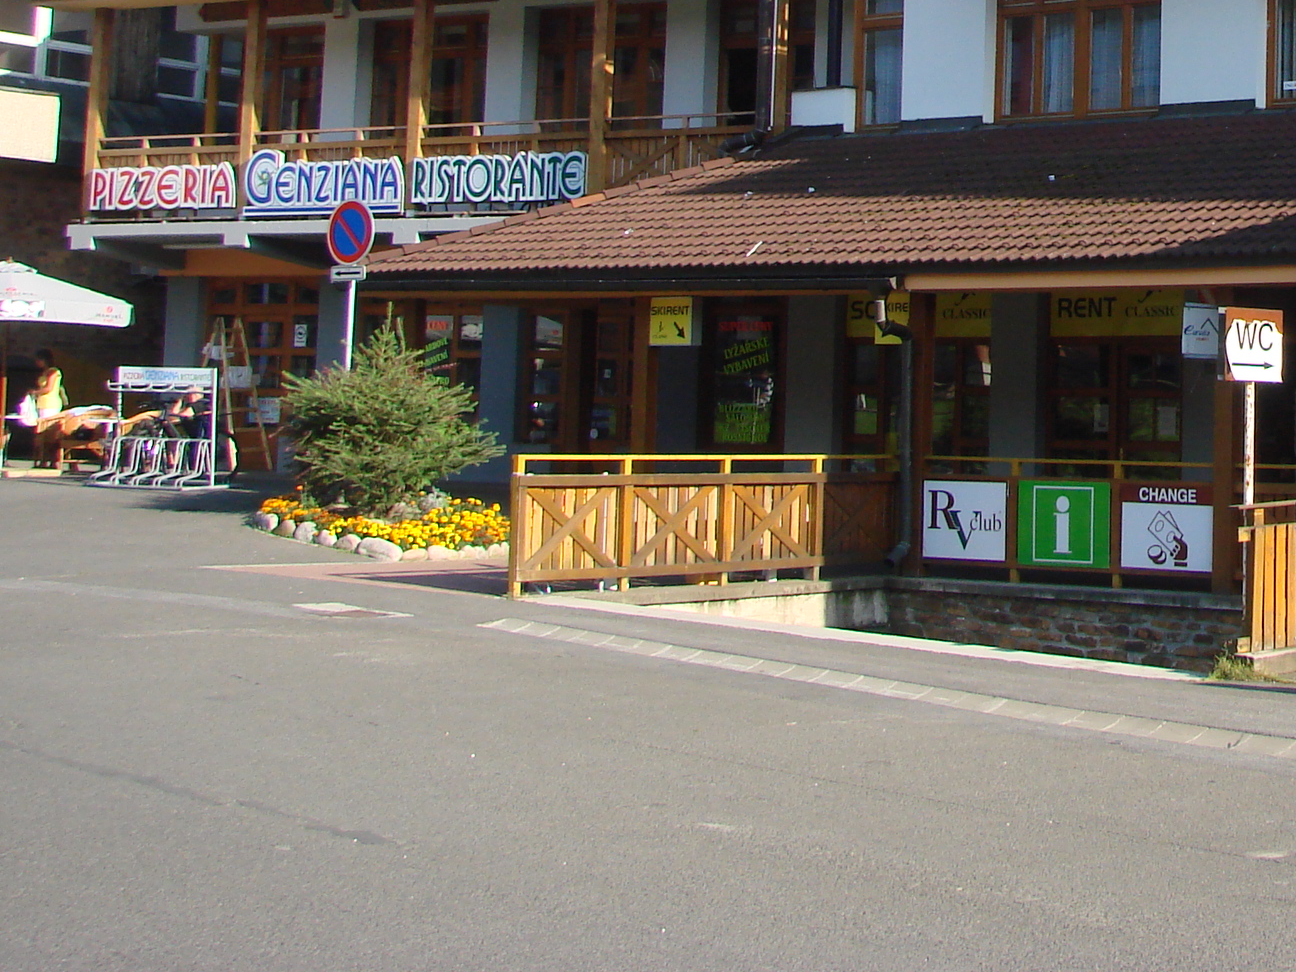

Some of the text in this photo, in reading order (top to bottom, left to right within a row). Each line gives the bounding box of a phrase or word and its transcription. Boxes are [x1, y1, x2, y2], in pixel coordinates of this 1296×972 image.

[91, 149, 588, 210] PIZZERIA GENZIANA RISTORANTE
[651, 305, 690, 316] SKIRENT
[942, 307, 991, 320] CLASSIC
[1058, 296, 1179, 319] RENT CLASSIC
[1235, 322, 1274, 352] WC
[1138, 486, 1198, 504] CHANGE
